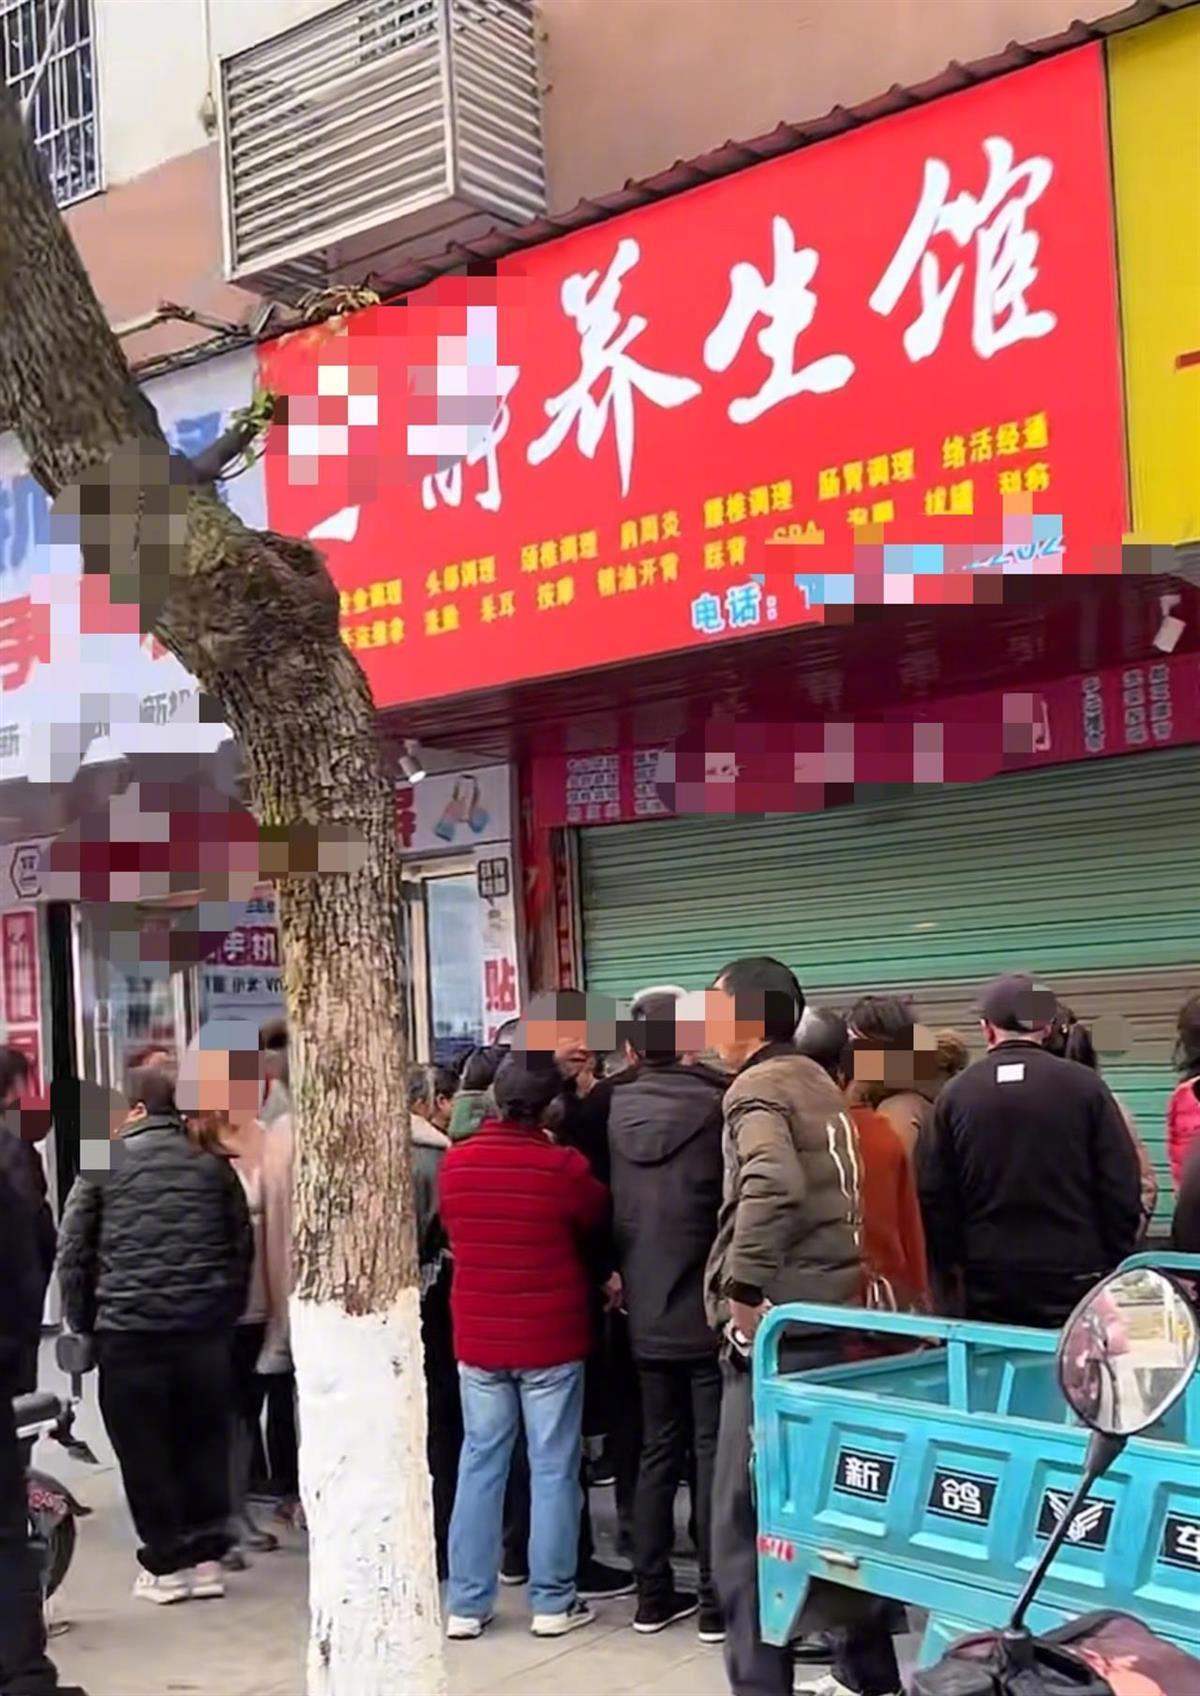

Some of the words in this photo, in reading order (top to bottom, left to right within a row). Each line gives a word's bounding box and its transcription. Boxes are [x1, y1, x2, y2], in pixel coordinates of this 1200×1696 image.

[308, 135, 1057, 541] 养生馆
[620, 511, 681, 550] 肩周炎
[818, 448, 914, 500] 肠胃调理
[597, 552, 679, 596] 精油开背
[844, 1456, 881, 1492] 新
[941, 1477, 983, 1516] 鸽
